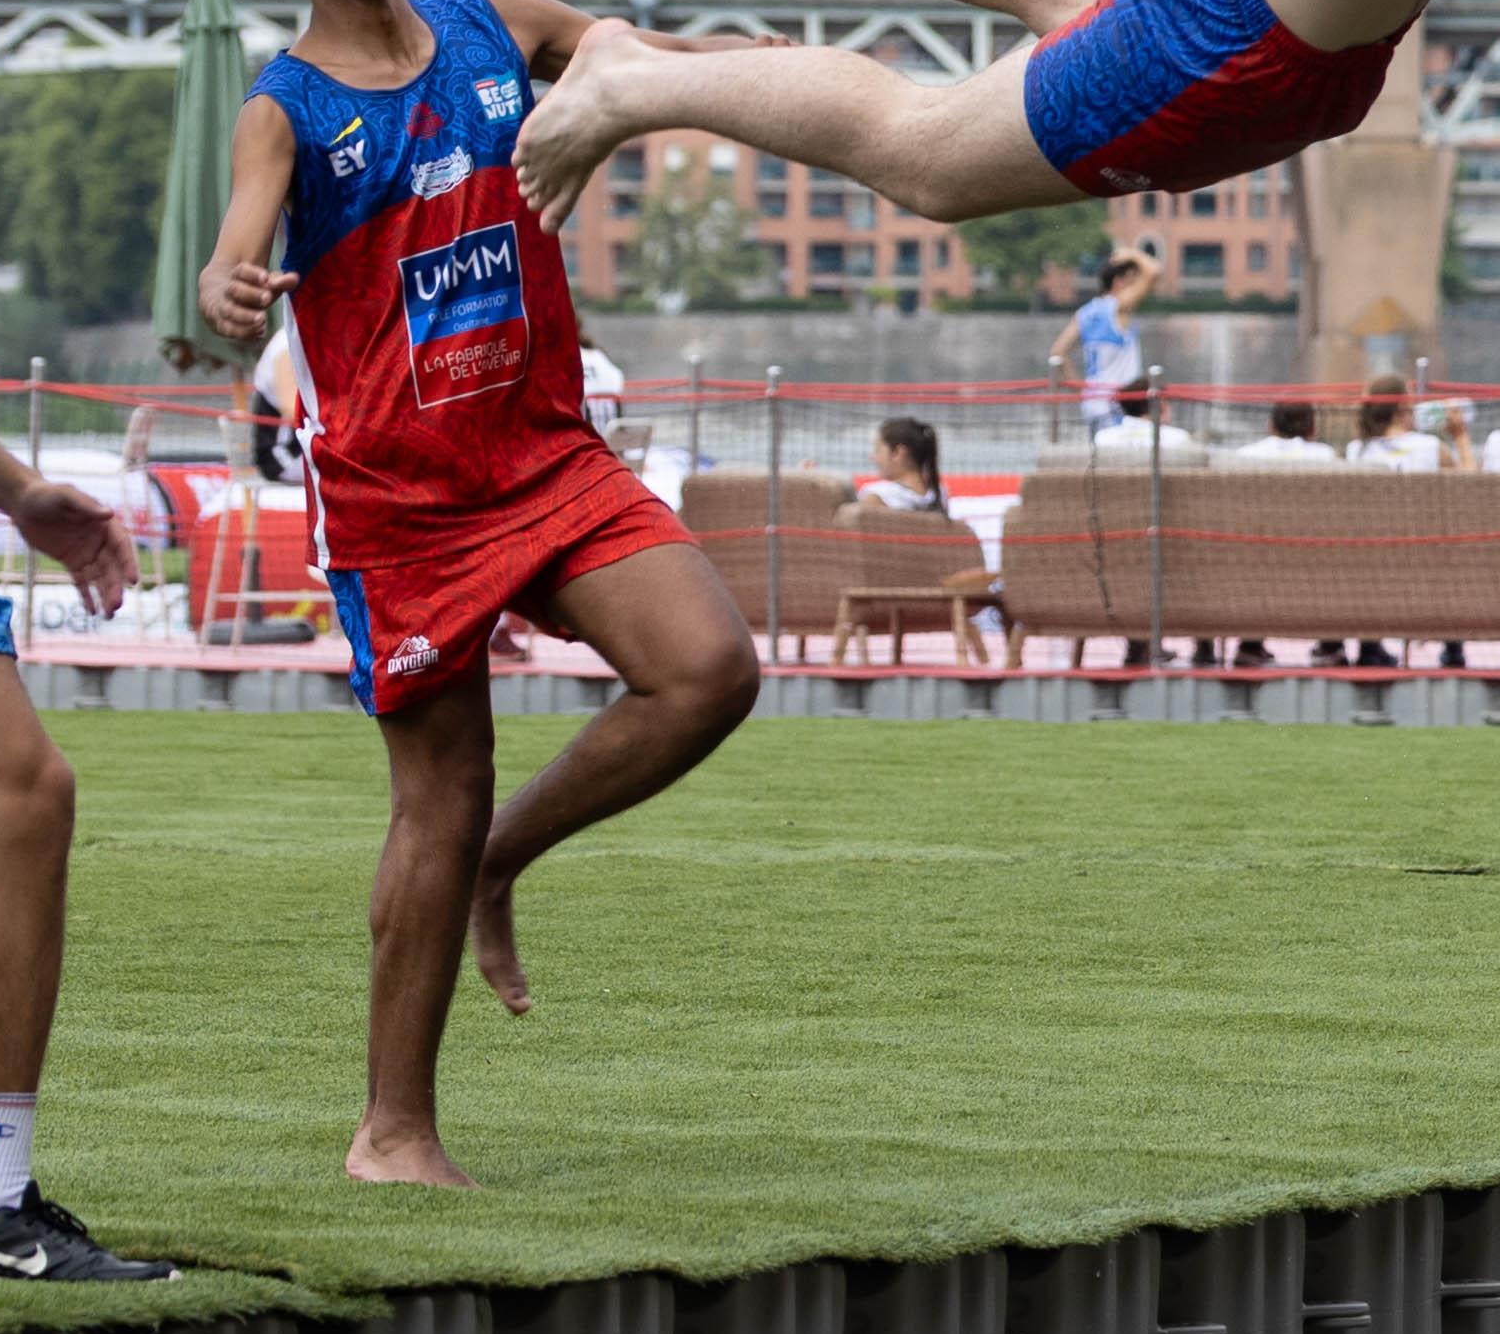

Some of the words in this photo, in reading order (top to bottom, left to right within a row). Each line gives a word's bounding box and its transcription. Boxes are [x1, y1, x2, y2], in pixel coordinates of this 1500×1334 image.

[328, 138, 367, 178] EY
[414, 240, 513, 301] UIMM
[424, 356, 445, 373] LA
[450, 365, 472, 381] DE
[387, 648, 439, 674] OXYGEAR
